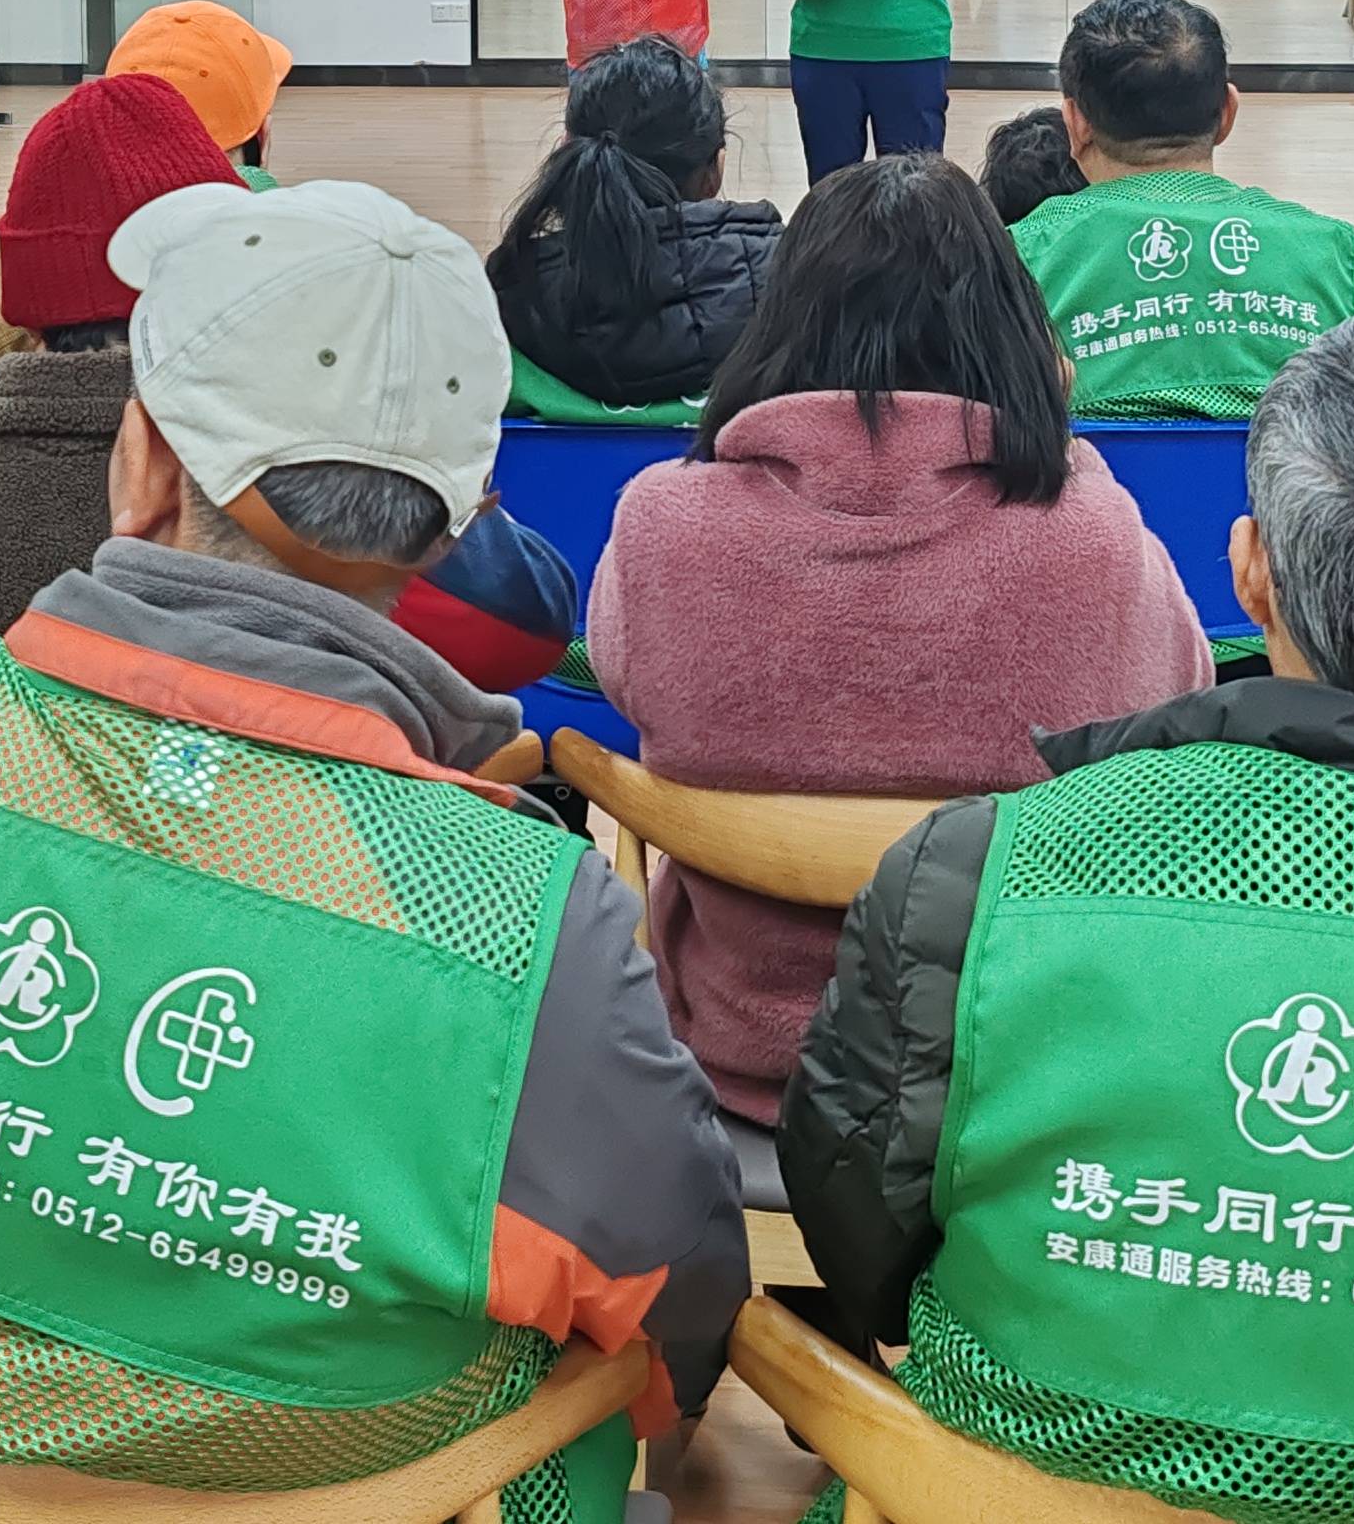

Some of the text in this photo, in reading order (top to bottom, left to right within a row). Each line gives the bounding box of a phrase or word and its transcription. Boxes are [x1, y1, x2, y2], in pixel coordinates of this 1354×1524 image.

[1071, 289, 1321, 339] 携手同行 有你有我
[78, 1136, 362, 1272] 有你有我
